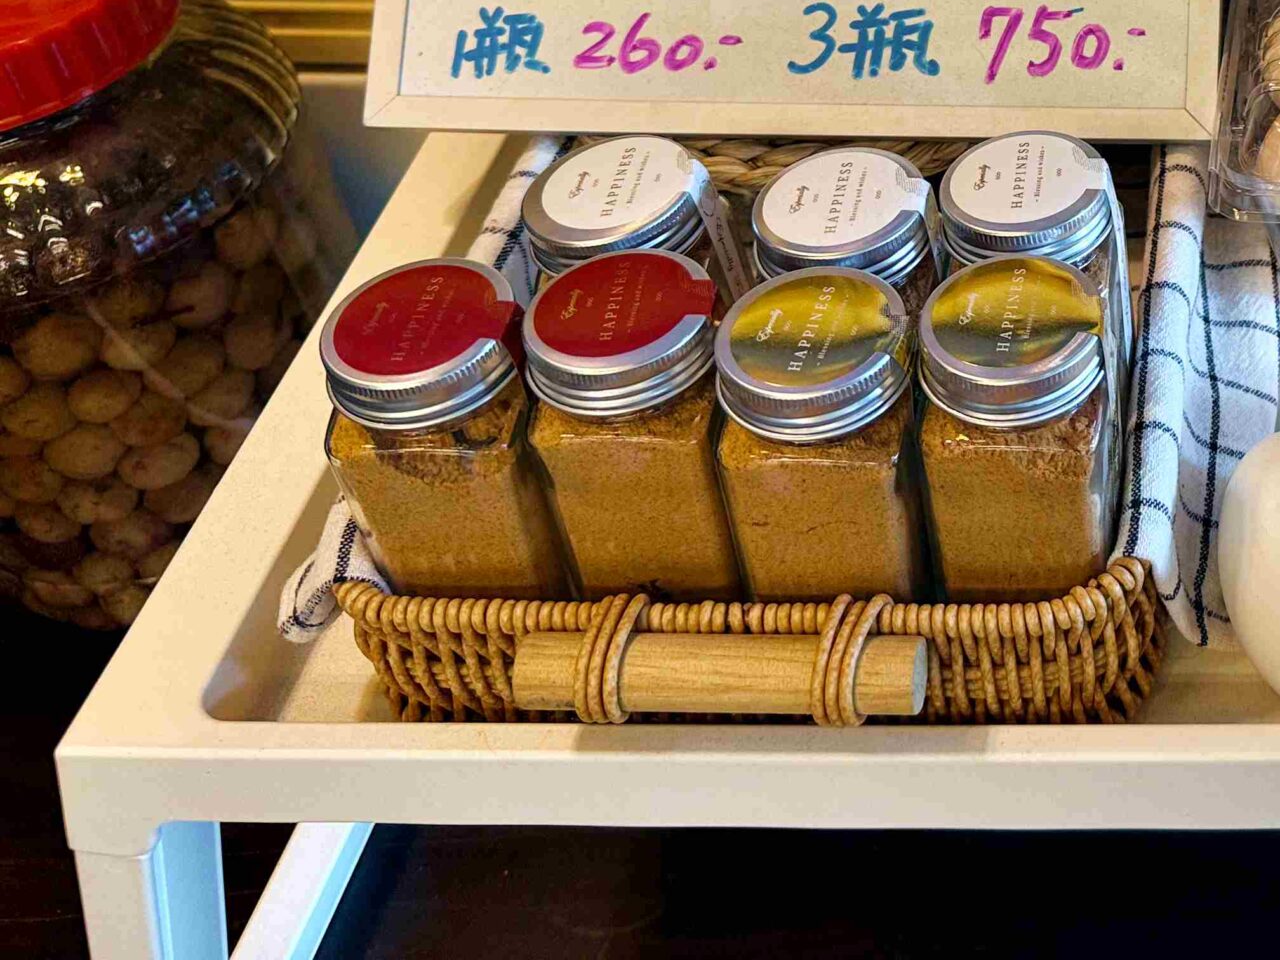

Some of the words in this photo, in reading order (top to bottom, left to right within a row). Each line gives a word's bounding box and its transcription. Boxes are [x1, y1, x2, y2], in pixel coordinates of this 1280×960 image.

[785, 1, 942, 80] 3瓶
[600, 147, 637, 218] HAPPINESS
[823, 161, 854, 234] HAPPINESS
[1010, 141, 1031, 209] HAPPINESS
[390, 276, 444, 361] HAPPINESS
[599, 261, 632, 341] HAPPINESS
[786, 285, 836, 372] HAPPINESS
[995, 268, 1027, 353] HAPPINESS
